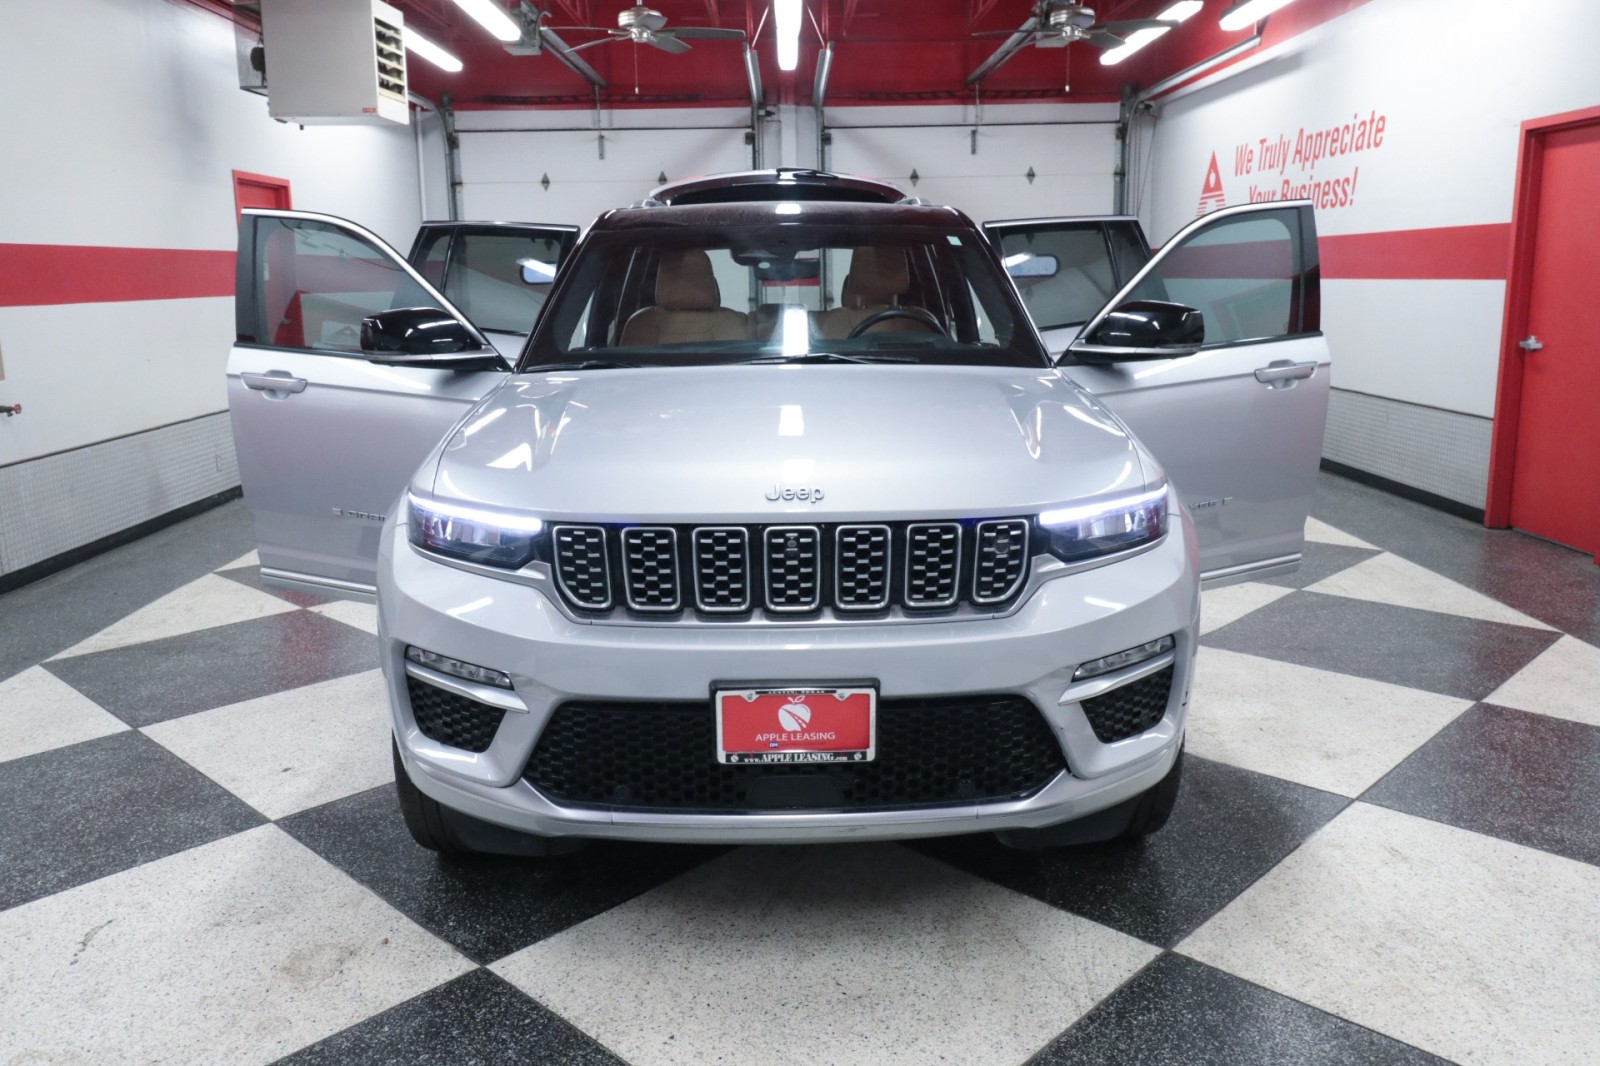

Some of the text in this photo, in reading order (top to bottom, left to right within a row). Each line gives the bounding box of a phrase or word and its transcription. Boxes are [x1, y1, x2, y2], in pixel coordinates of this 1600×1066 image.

[1235, 110, 1386, 176] We Truly Appreciate
[765, 483, 824, 503] Jeep
[755, 732, 836, 741] APPLE LEASING
